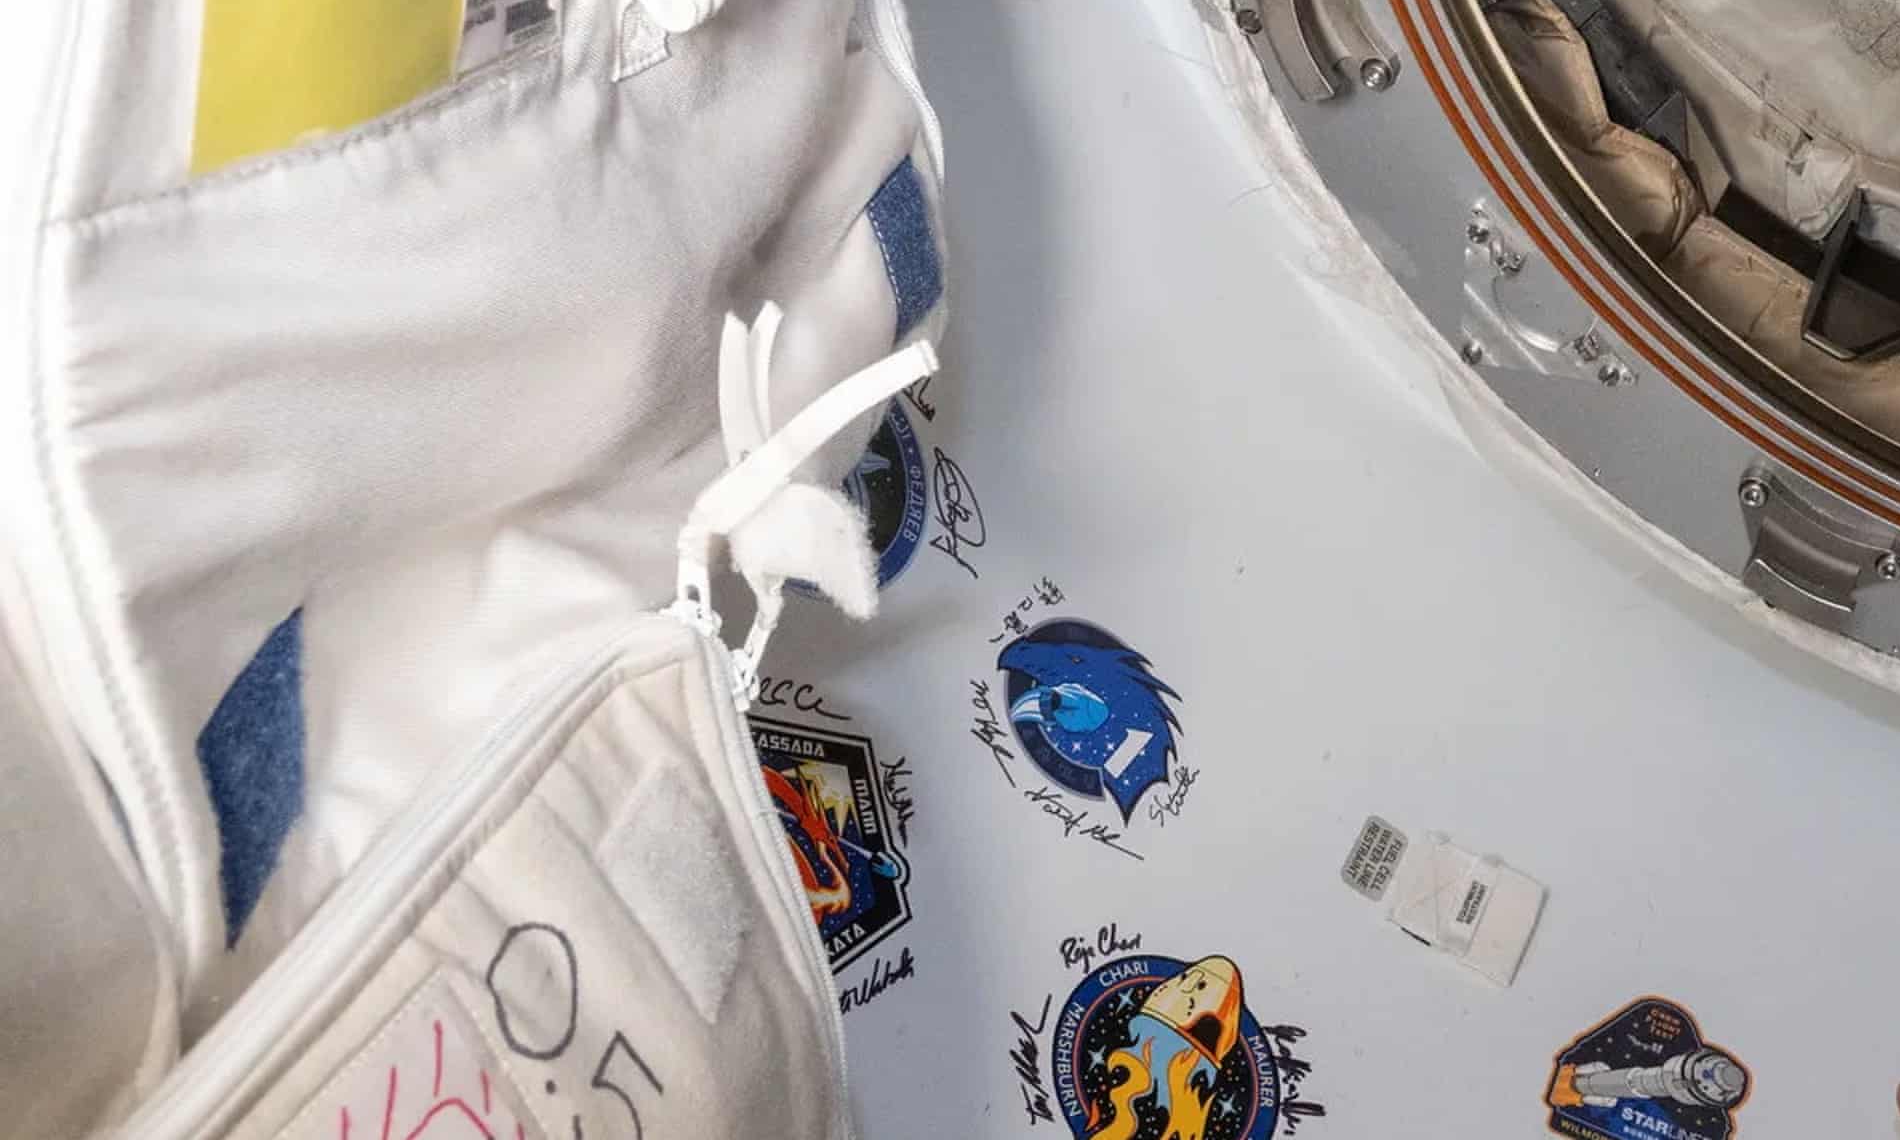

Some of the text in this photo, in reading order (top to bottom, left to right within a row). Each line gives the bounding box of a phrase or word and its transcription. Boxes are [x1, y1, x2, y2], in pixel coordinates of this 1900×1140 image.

[903, 464, 925, 543] ФЕДЯЕВ
[751, 731, 826, 758] ASSADA
[1099, 961, 1150, 988] CHARI
[1055, 1001, 1085, 1118] MARSHBURN
[1248, 1034, 1274, 1109] MAURER
